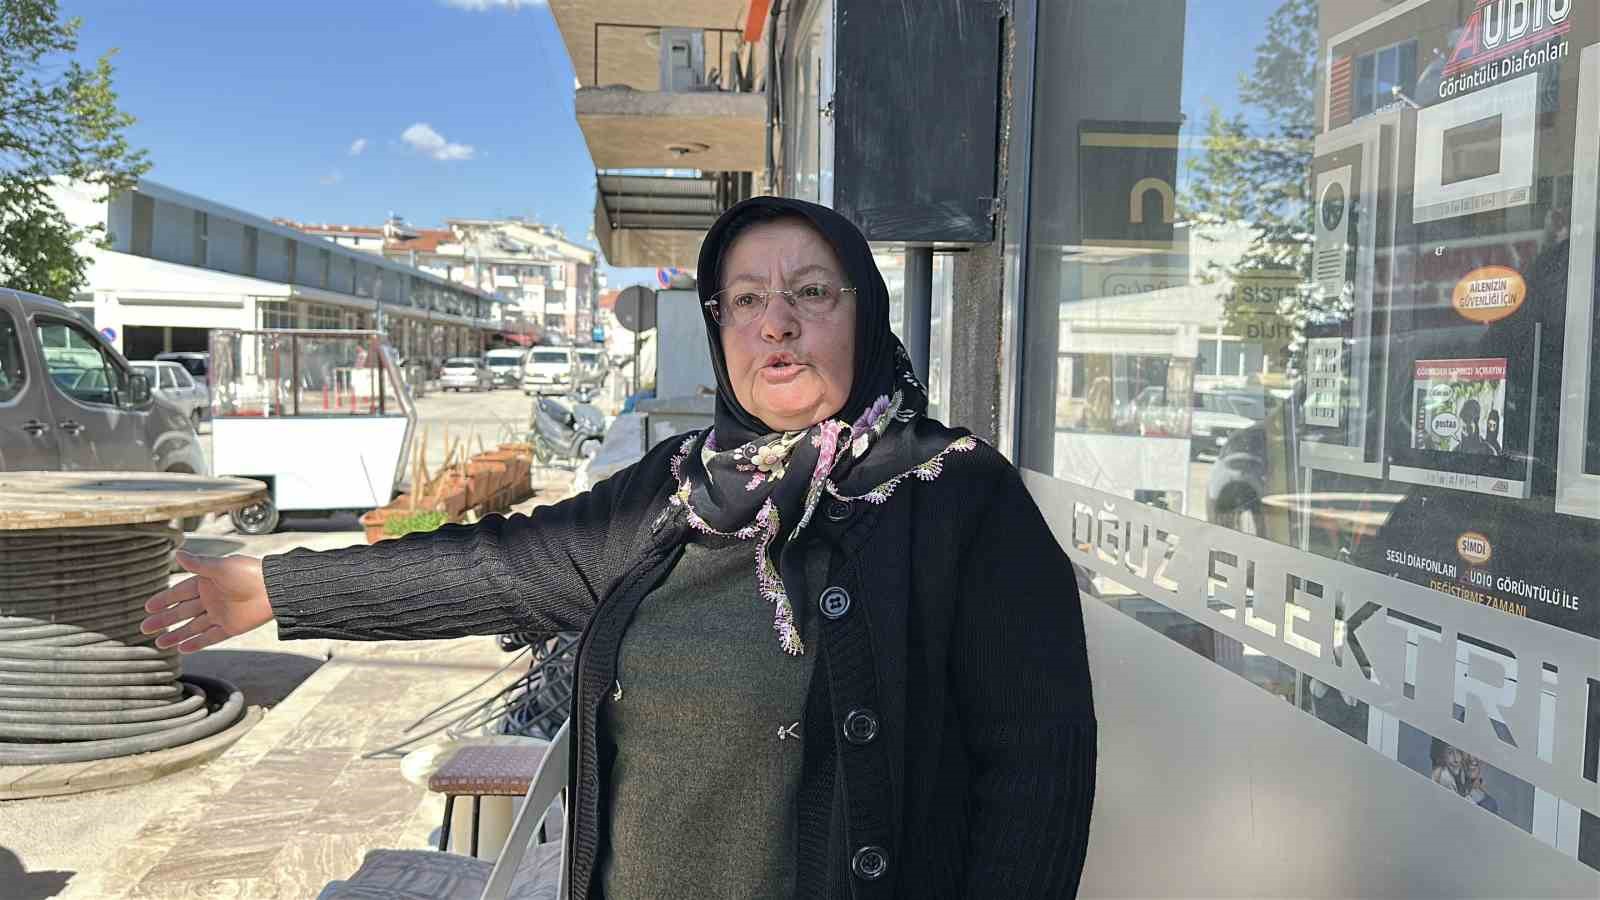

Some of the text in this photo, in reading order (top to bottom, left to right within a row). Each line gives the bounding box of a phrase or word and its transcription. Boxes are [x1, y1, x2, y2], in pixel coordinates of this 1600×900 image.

[1439, 41, 1569, 98] Görüntülü Diafonları
[1072, 500, 1181, 594] OĞUZ
[1462, 537, 1486, 555] ŞİMDİ
[1386, 549, 1406, 565] SESLİ
[1407, 553, 1457, 578] DİAFONLARI
[1496, 575, 1560, 605] GÖRÜNTÜLÜ
[1562, 590, 1580, 610] İLE
[1485, 594, 1527, 616] ZAMANI
